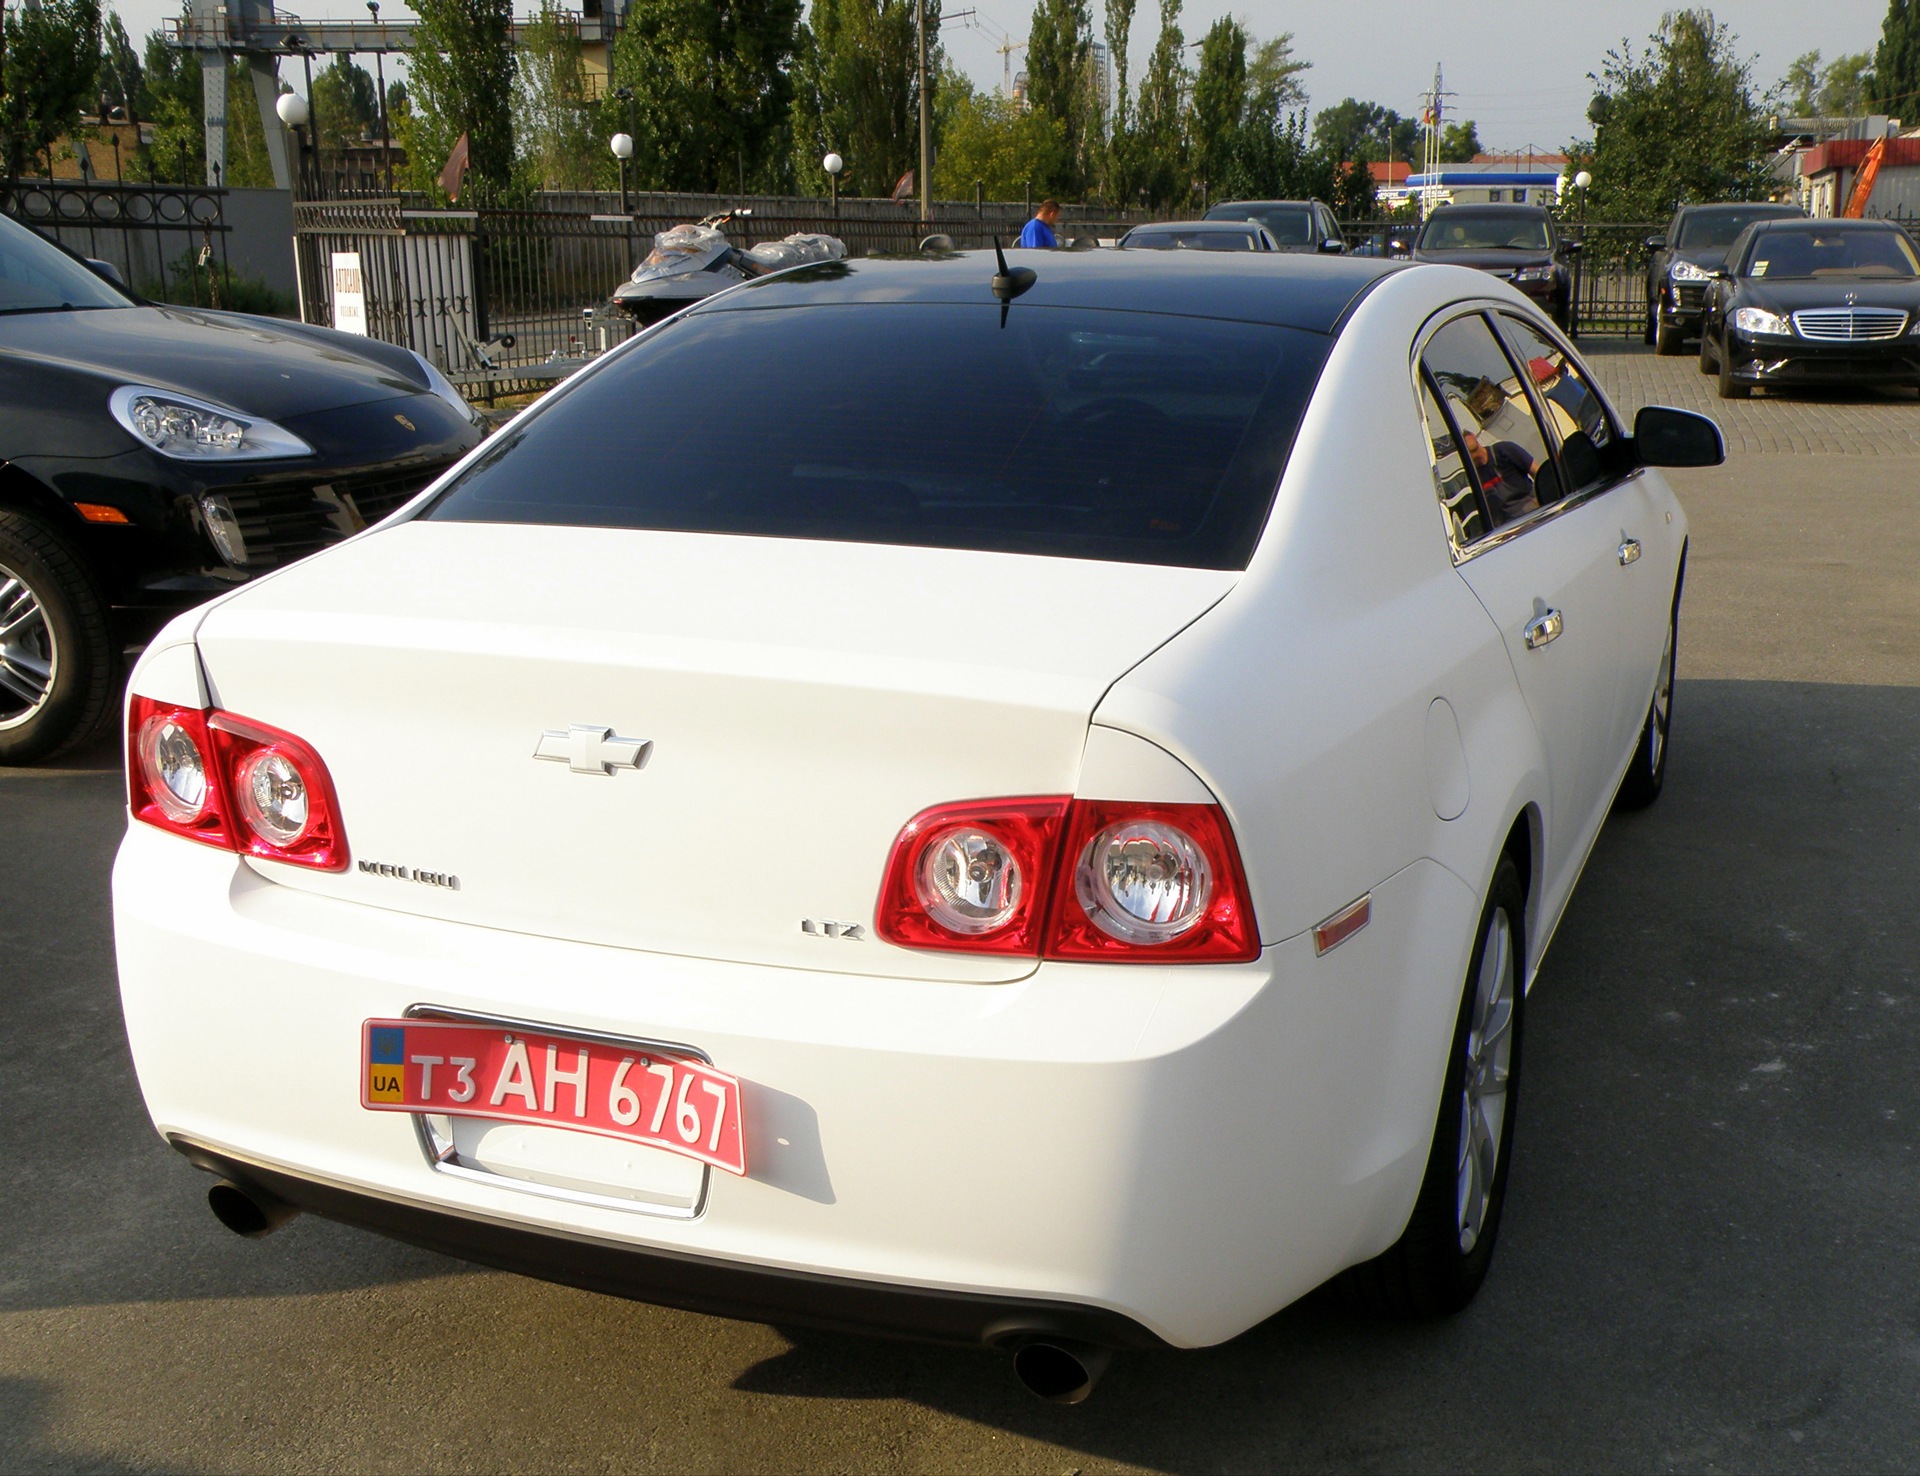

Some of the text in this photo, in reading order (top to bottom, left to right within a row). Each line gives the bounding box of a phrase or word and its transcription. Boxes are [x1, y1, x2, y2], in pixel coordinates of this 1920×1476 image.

[358, 860, 461, 891] MALIBU
[800, 918, 866, 941] LTZ
[373, 1075, 401, 1092] UA
[411, 1039, 727, 1152] T3 AH 6767
